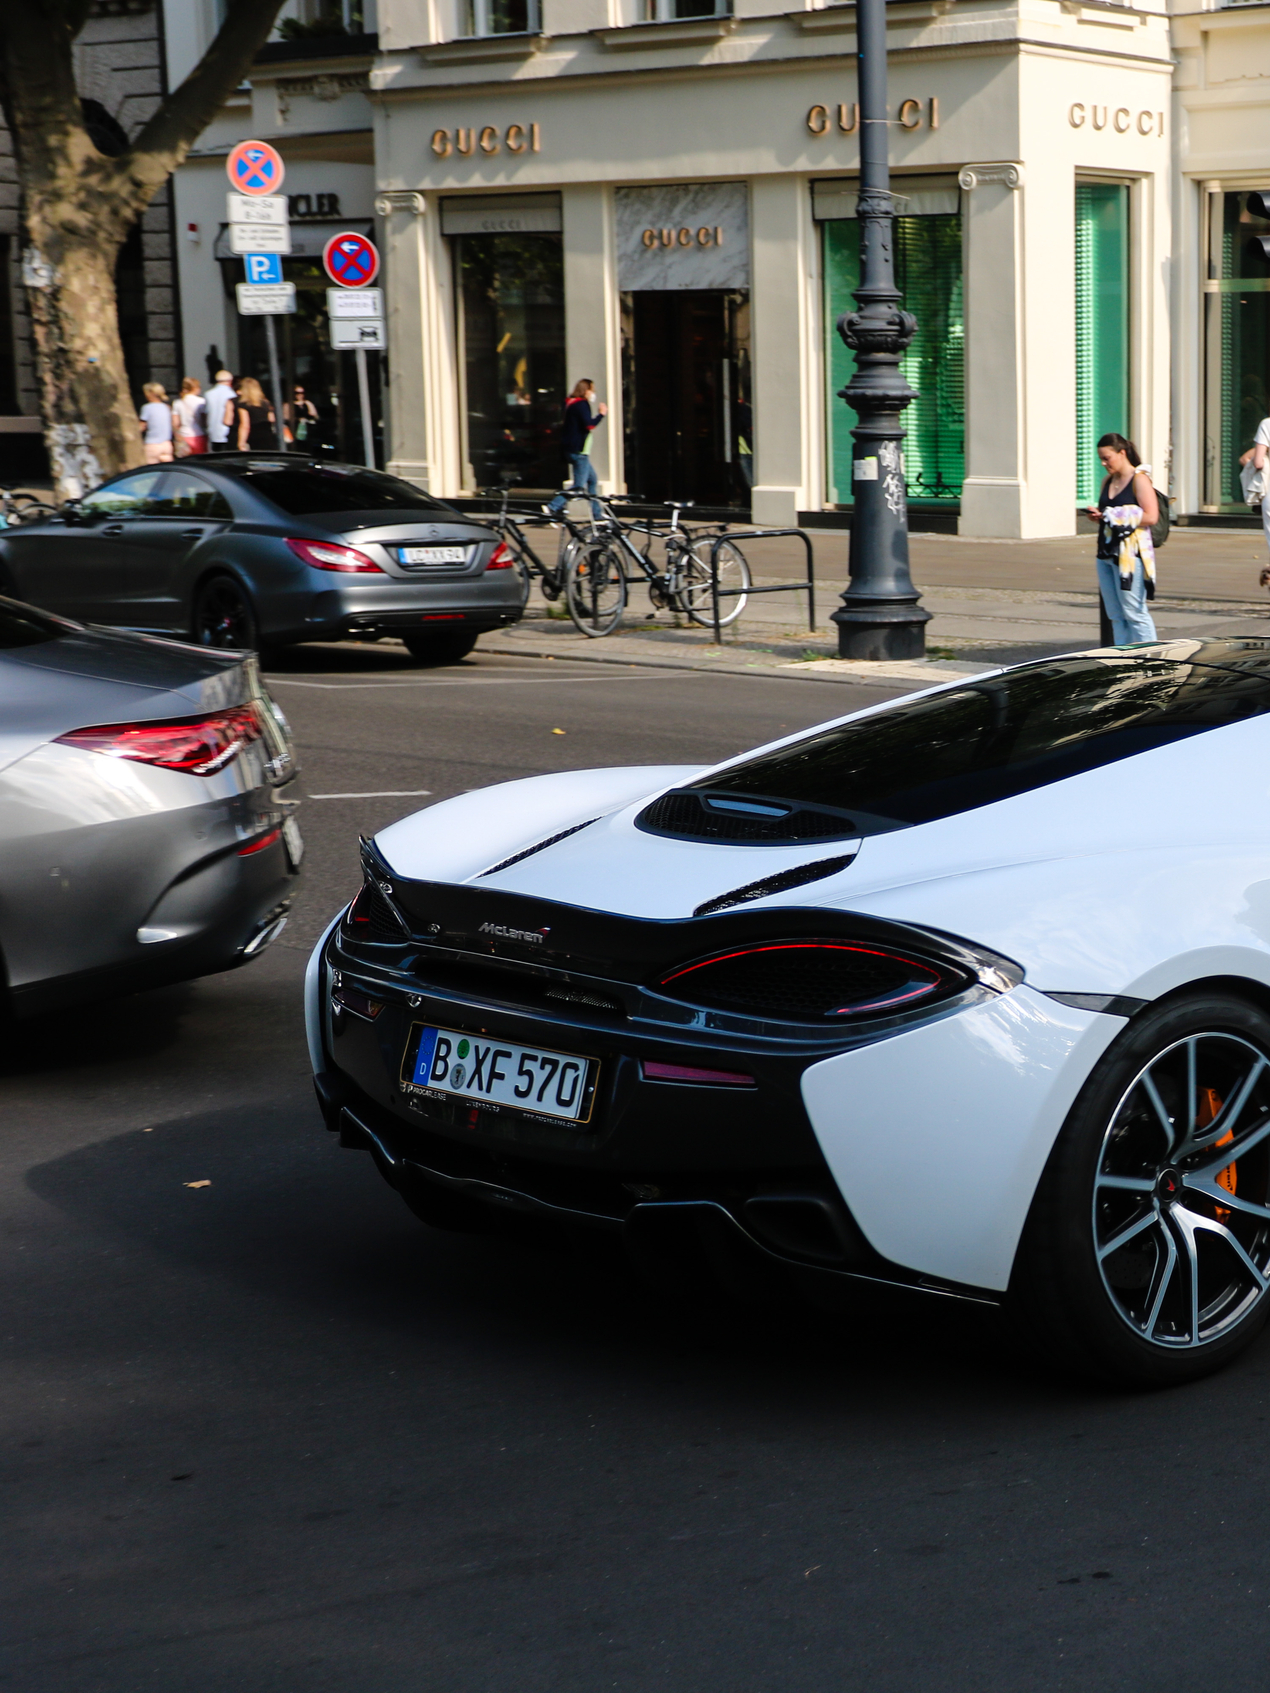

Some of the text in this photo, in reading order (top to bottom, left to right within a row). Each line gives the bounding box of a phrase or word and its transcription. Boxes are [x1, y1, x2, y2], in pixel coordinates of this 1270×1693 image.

[806, 97, 940, 136] GUCI
[1067, 102, 1165, 138] GUCCI
[431, 122, 542, 159] GUCCI
[642, 226, 723, 249] GUCCI
[250, 255, 271, 281] P
[478, 922, 544, 944] McLaren
[419, 1062, 427, 1075] D
[430, 1036, 581, 1108] B XF 570
